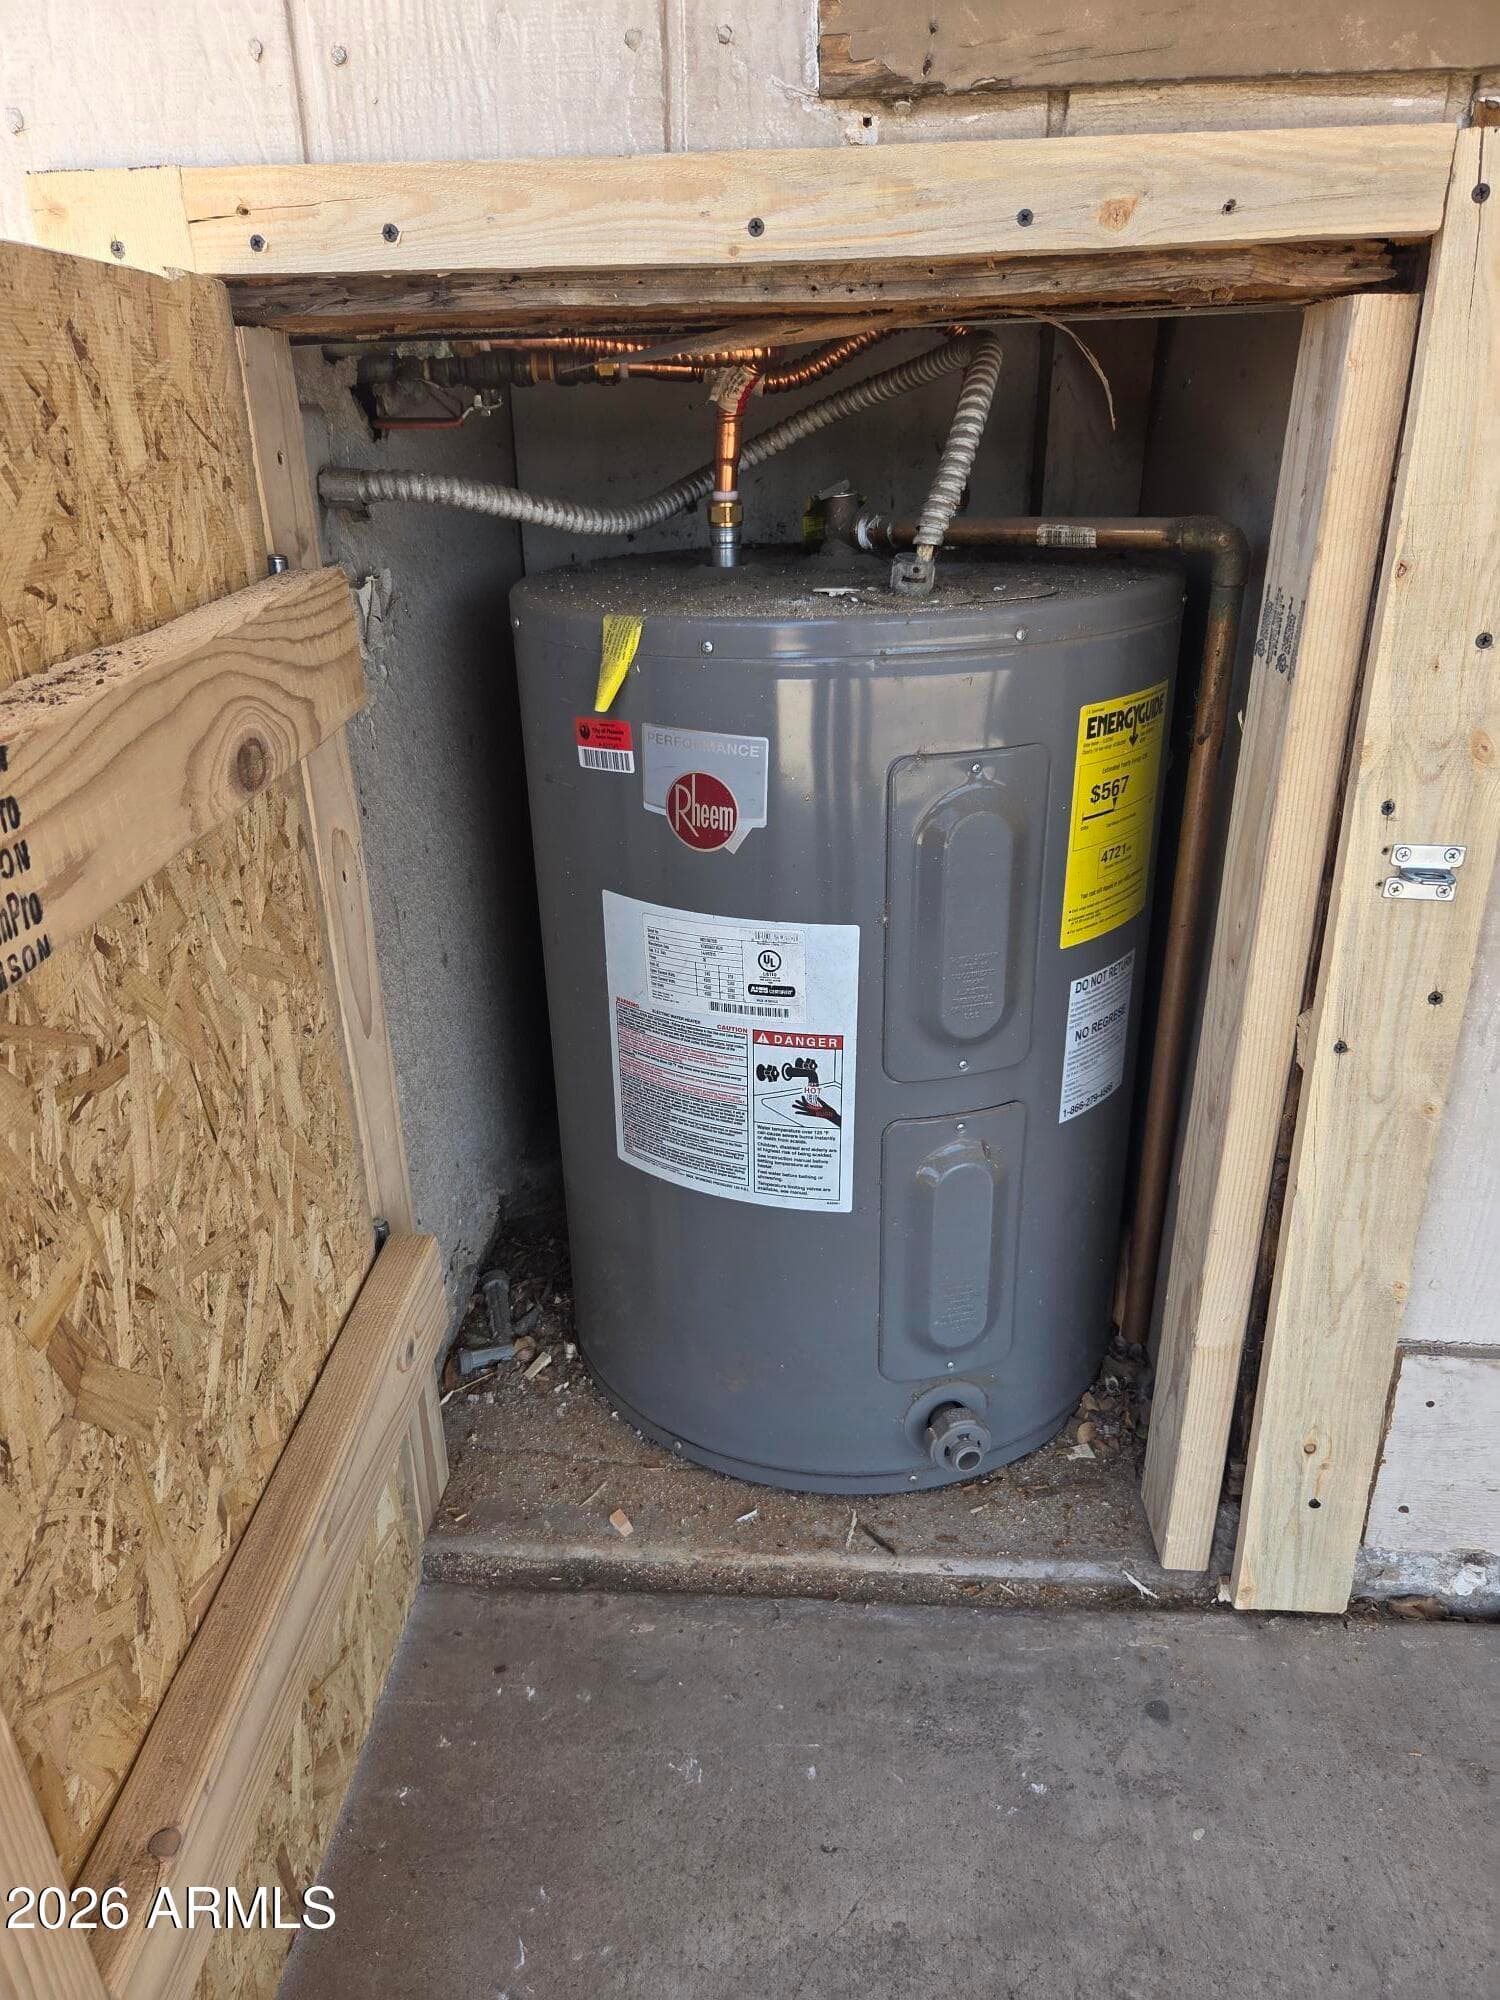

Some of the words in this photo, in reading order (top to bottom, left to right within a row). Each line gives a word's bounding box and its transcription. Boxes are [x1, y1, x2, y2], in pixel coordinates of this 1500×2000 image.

[646, 731, 760, 758] PERFORMANCE
[1090, 774, 1130, 806] $567
[675, 773, 734, 837] Rheem
[1100, 842, 1127, 863] 4721
[763, 954, 776, 968] UL
[1075, 979, 1089, 994] DO
[1090, 969, 1109, 988] NOT
[716, 1024, 748, 1034] CAUTION
[1074, 1026, 1090, 1042] NO
[774, 1034, 837, 1048] DANGER
